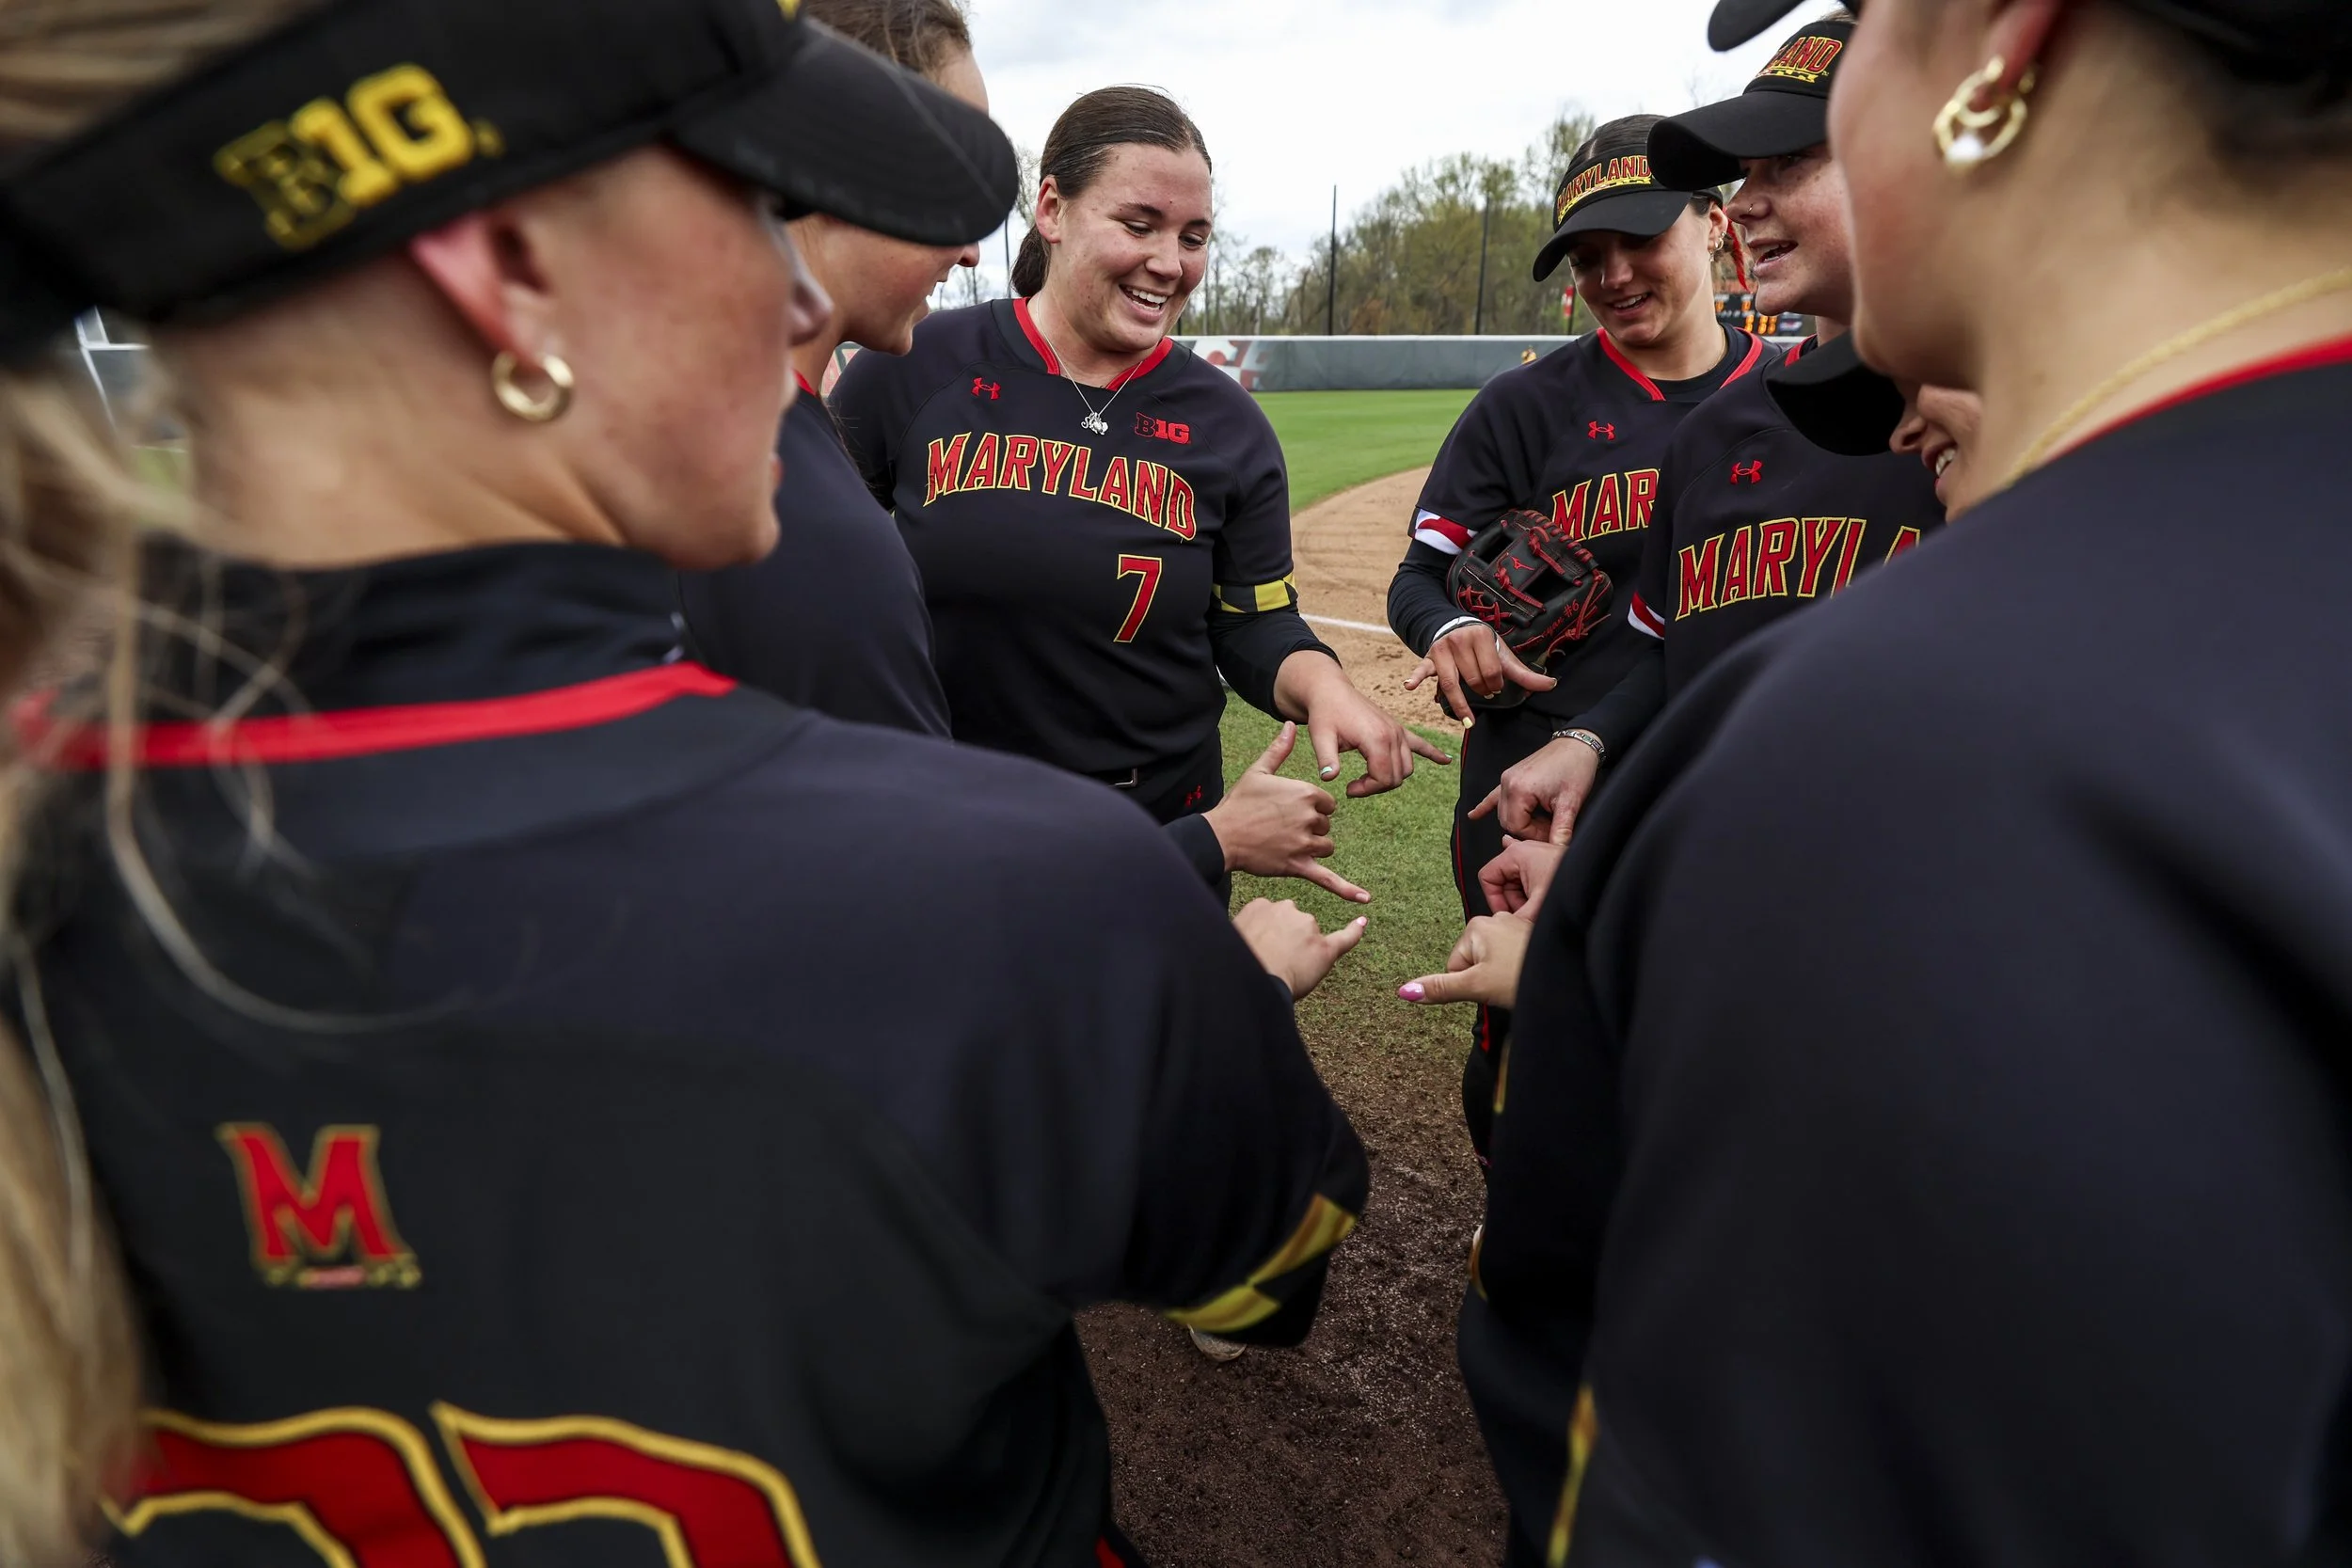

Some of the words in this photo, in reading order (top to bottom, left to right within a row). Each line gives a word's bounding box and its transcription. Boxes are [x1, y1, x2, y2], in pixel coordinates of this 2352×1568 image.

[1556, 154, 1653, 218] MARYLAND
[923, 431, 1197, 541] MARYLAND
[1113, 553, 1162, 643] 7
[213, 1121, 421, 1288] M
